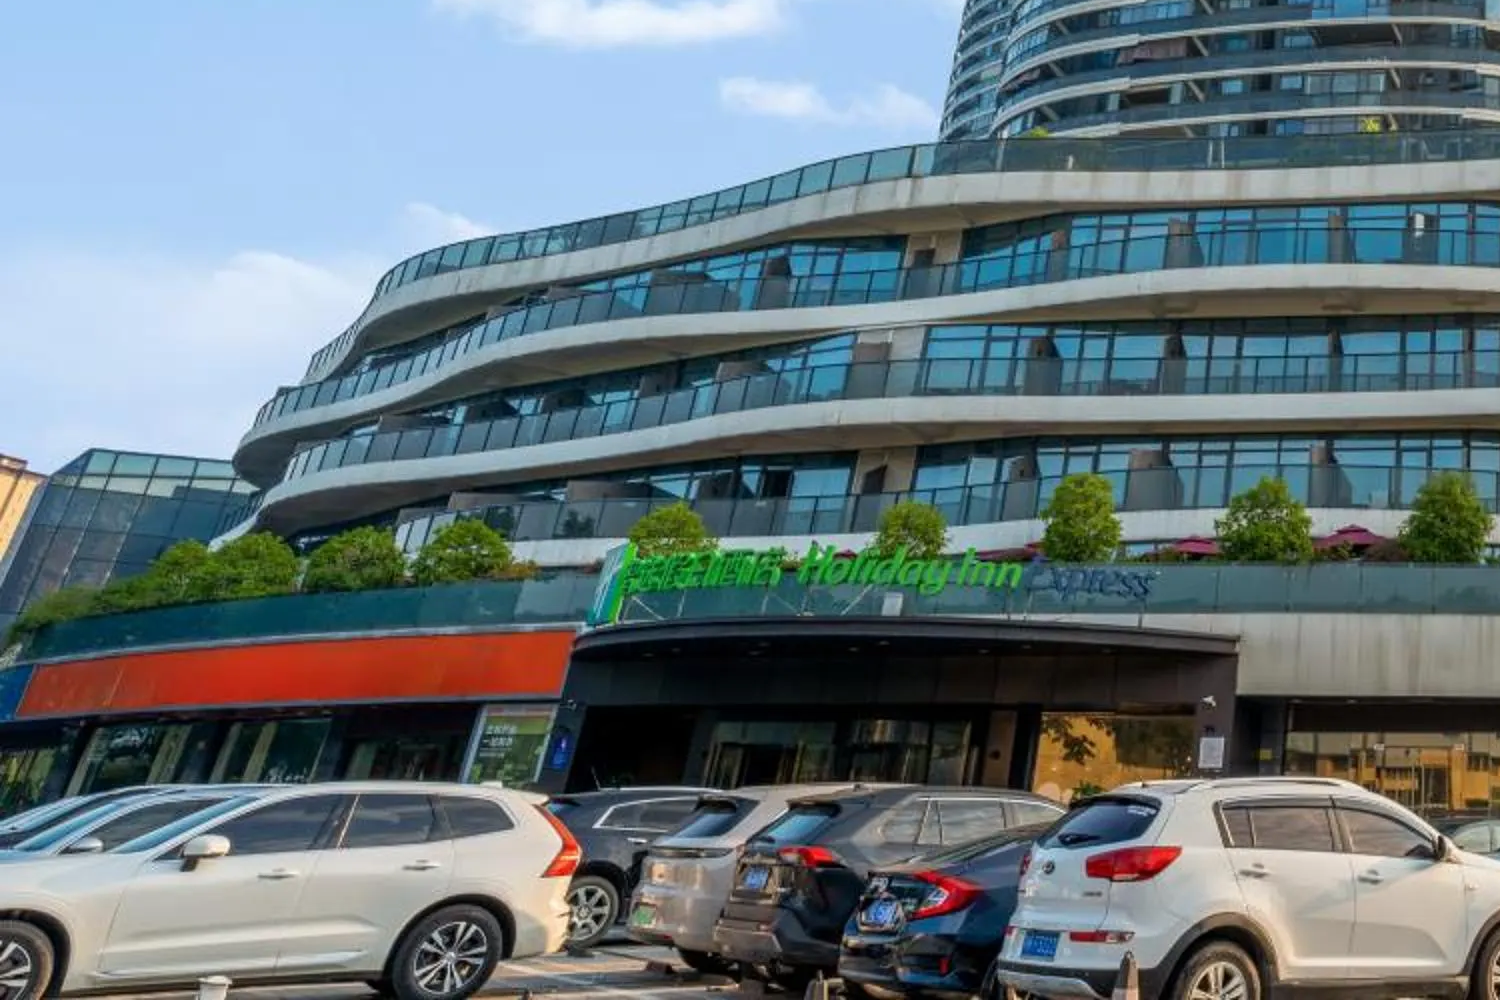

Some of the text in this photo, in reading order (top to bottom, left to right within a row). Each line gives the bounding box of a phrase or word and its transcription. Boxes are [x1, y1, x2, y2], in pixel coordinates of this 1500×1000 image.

[799, 540, 1157, 600] Holiday Inn Express
